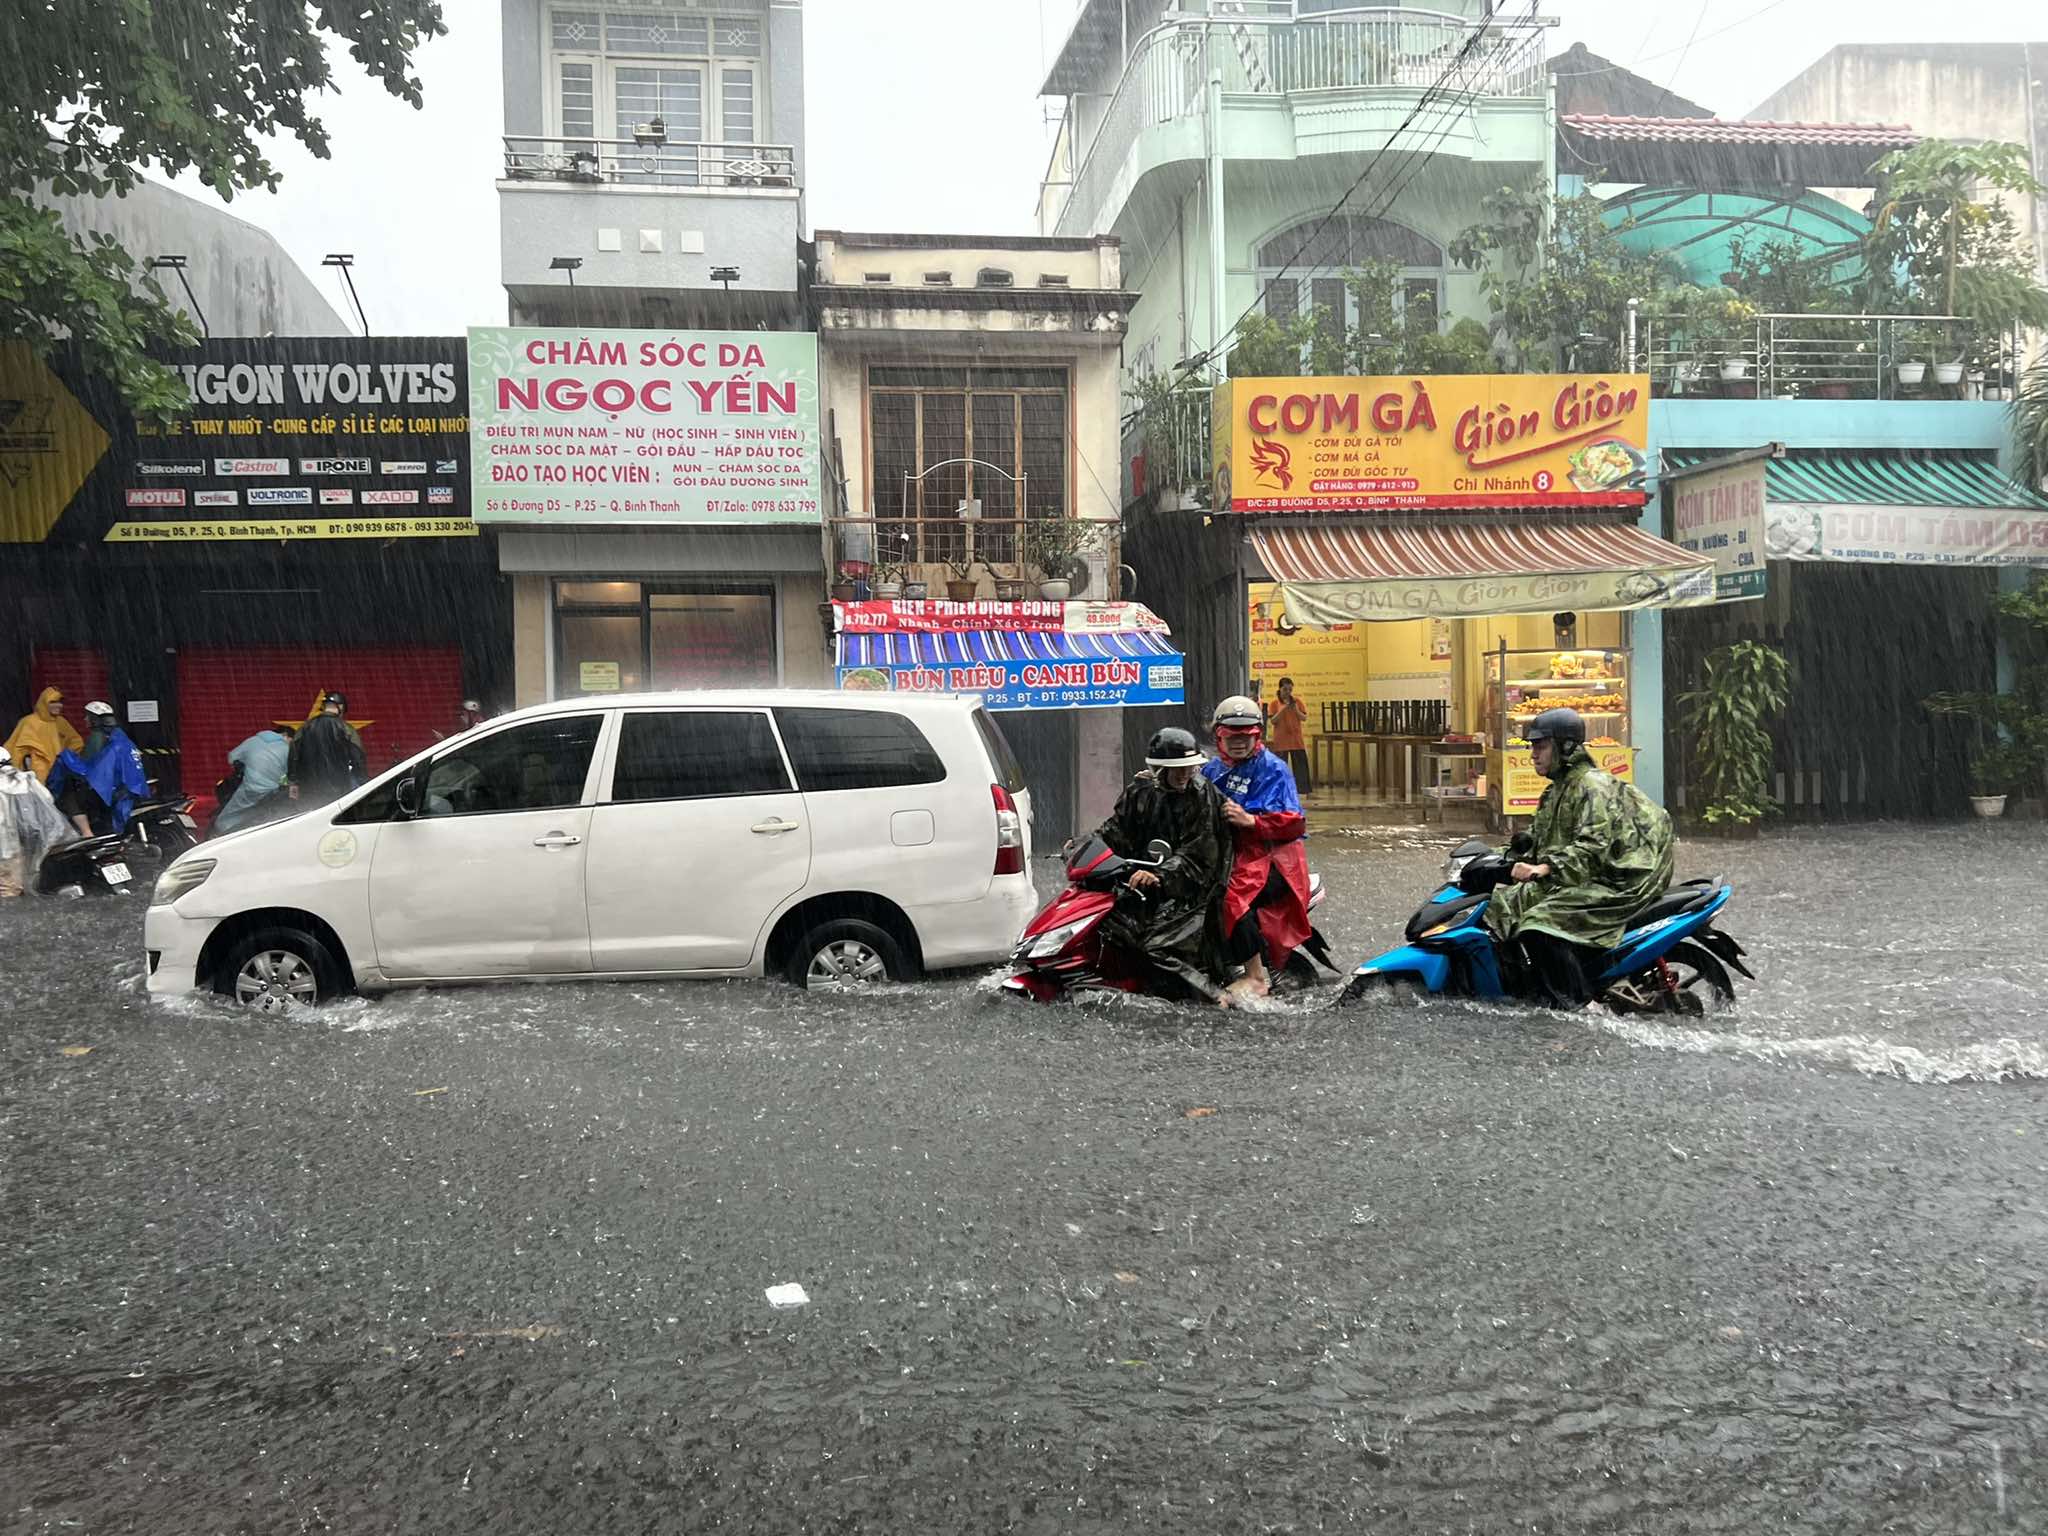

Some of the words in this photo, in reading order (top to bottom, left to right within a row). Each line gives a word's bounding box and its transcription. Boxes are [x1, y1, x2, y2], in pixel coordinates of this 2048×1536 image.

[526, 336, 628, 366] CHĂM
[639, 336, 706, 367] SÓC
[718, 343, 766, 368] DA
[292, 362, 457, 404] WOLVES
[497, 377, 672, 420] NGỌC
[687, 370, 797, 413] YẾN
[1247, 393, 1360, 434] CƠM
[1371, 380, 1438, 433] GÀ
[1454, 403, 1541, 453] Giòn
[1553, 380, 1639, 431] Giòn
[191, 420, 225, 435] THAY
[578, 427, 608, 438] NAM
[687, 428, 718, 439] SINH
[735, 429, 765, 439] SINH
[567, 445, 586, 456] DA
[140, 462, 202, 475] Silkolene
[234, 461, 279, 473] Castrol
[316, 460, 367, 472] IPONE
[784, 465, 801, 473] DA
[779, 477, 809, 487] SINH
[1484, 477, 1530, 490] Nhánh
[1537, 473, 1549, 490] 8
[128, 491, 183, 504] MOTUL
[250, 490, 309, 500] VOLTRONIC
[502, 500, 508, 511] 6
[547, 500, 561, 511] D5
[575, 500, 597, 511] P.25
[610, 501, 622, 513] Q.
[752, 501, 776, 512] 0978
[778, 501, 796, 512] 633
[799, 501, 817, 512] 799
[190, 527, 200, 536] P.
[297, 525, 317, 534] HCM
[384, 522, 407, 532] 6878
[415, 522, 432, 531] 093
[434, 521, 451, 531] 330
[898, 618, 940, 629] Nhanh
[895, 664, 945, 690] BÚN
[950, 661, 1006, 688] RIÊU
[1022, 664, 1087, 686] CANH
[1092, 658, 1140, 684] BÚN
[987, 693, 1008, 703] P.25
[1017, 692, 1032, 702] BT
[1041, 691, 1059, 701] ĐT:
[1061, 689, 1127, 700] 0933.152.247
